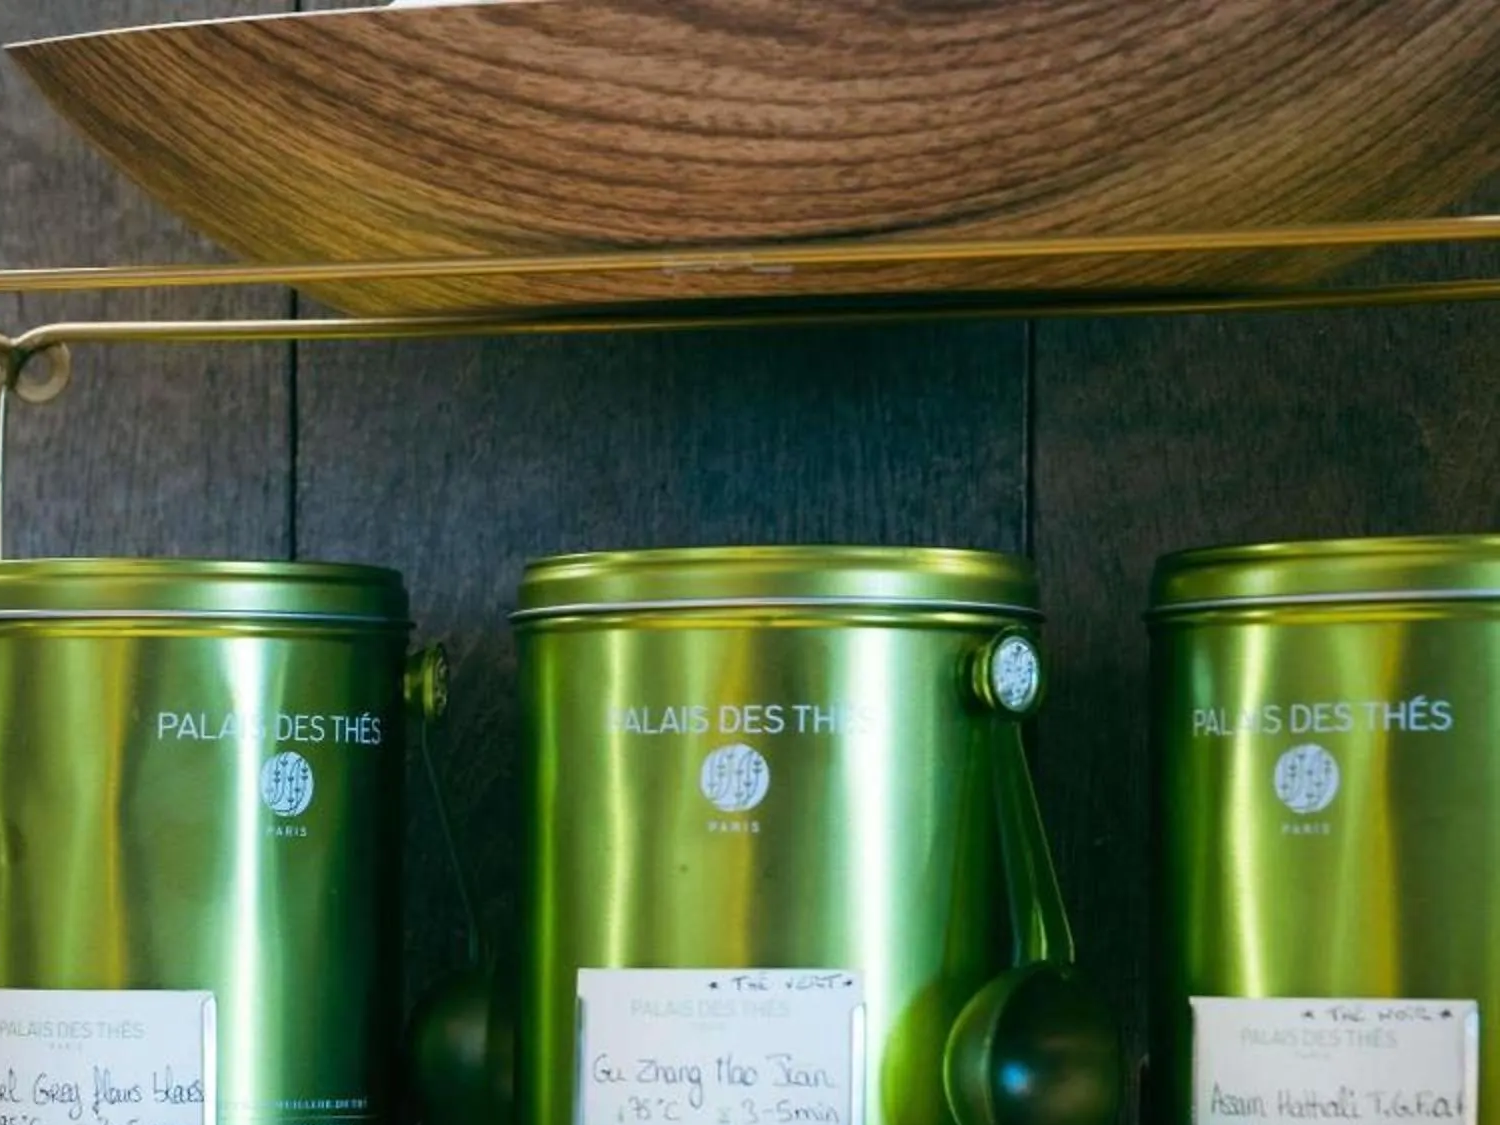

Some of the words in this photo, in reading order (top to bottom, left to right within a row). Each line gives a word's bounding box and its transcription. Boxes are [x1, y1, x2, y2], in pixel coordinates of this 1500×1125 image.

[157, 712, 264, 739] PALAS
[276, 714, 325, 742] DES
[331, 711, 382, 745] THÉS
[718, 704, 784, 735] DES
[1290, 703, 1353, 734] DES
[1363, 695, 1453, 732] THÉS
[266, 824, 307, 837] PARIS
[57, 1020, 93, 1039] DES
